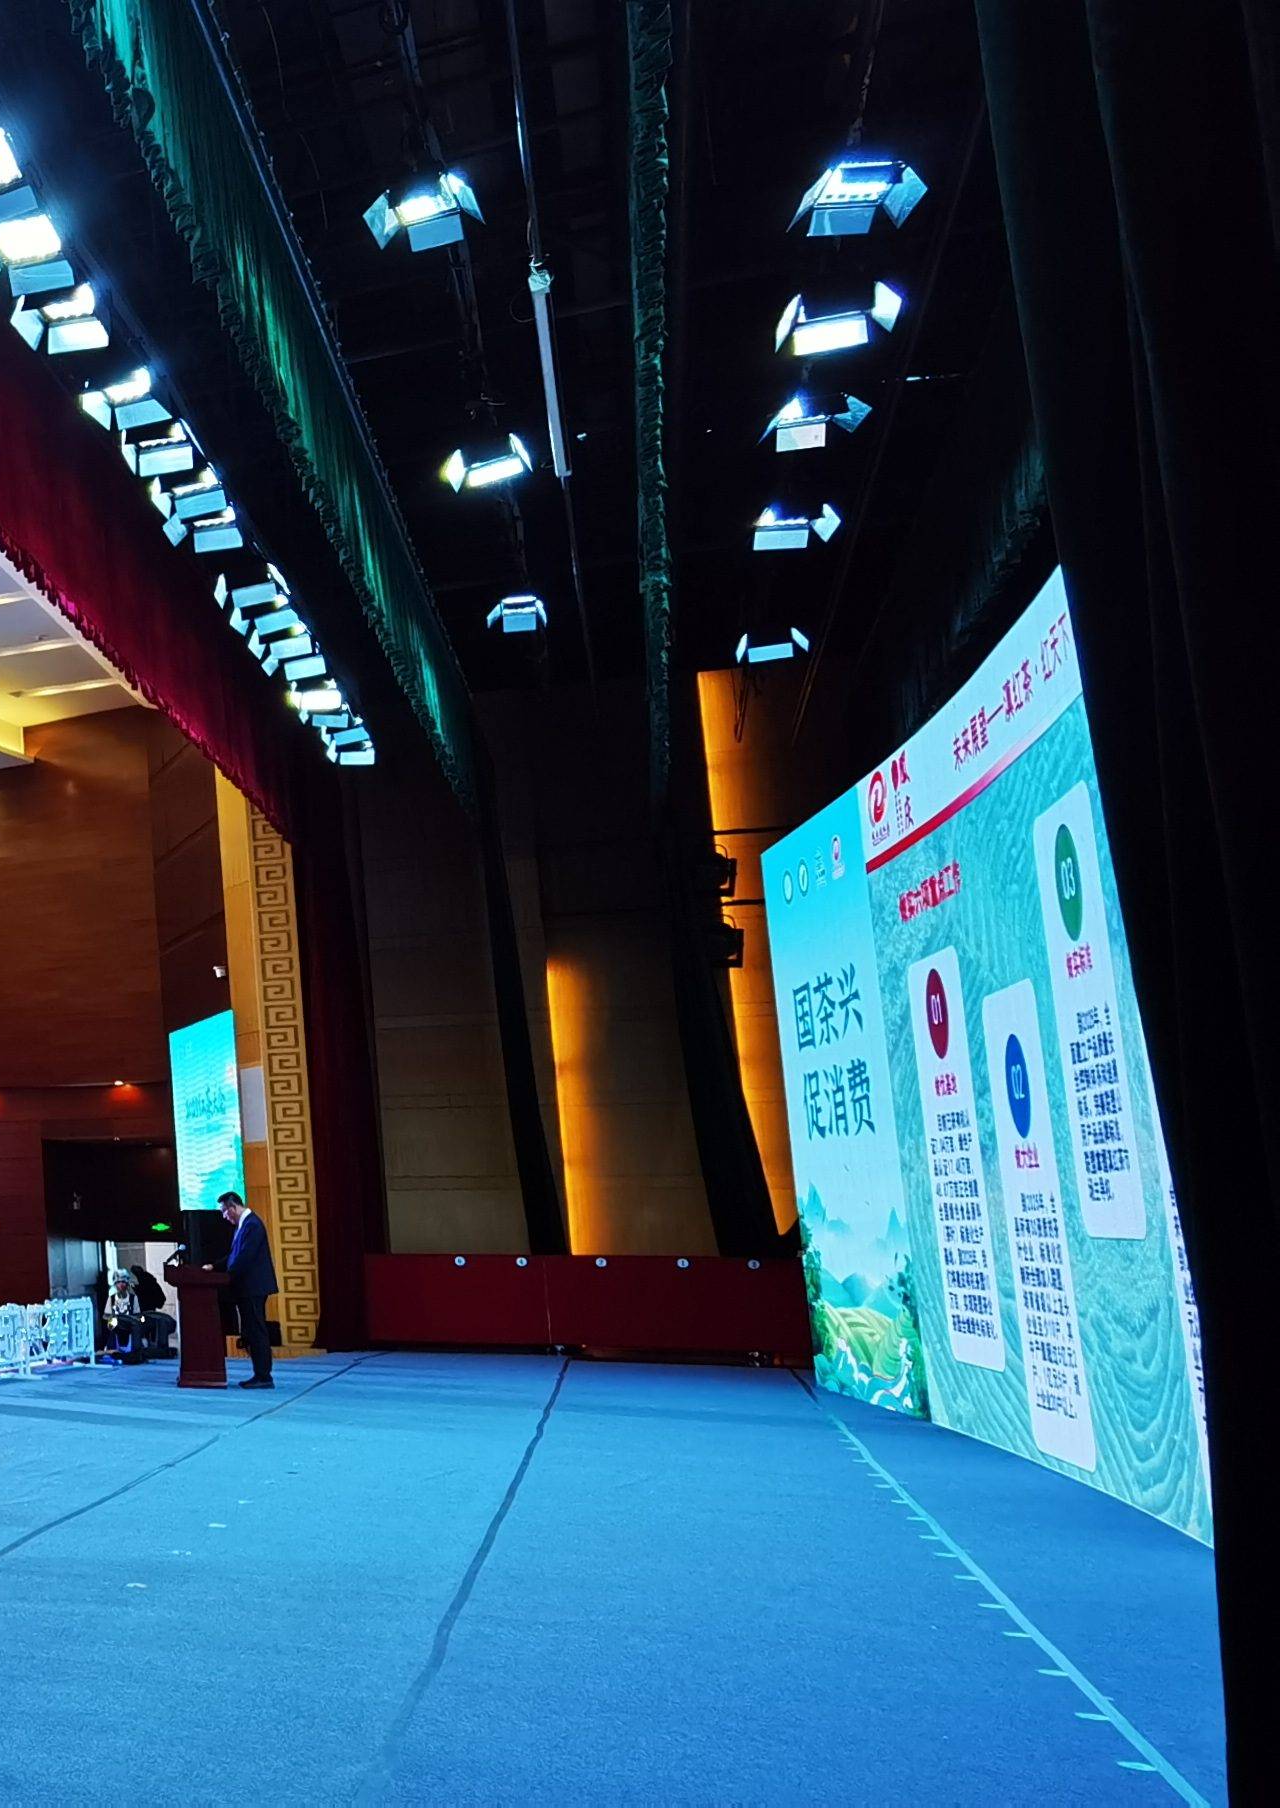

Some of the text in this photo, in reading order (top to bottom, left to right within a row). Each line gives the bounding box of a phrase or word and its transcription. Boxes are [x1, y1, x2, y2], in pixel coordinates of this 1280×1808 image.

[1060, 866, 1076, 902] 03
[791, 962, 864, 1052] 国茶兴
[929, 997, 943, 1025] 01
[802, 1058, 876, 1142] 促消费
[1010, 1069, 1026, 1101] 02
